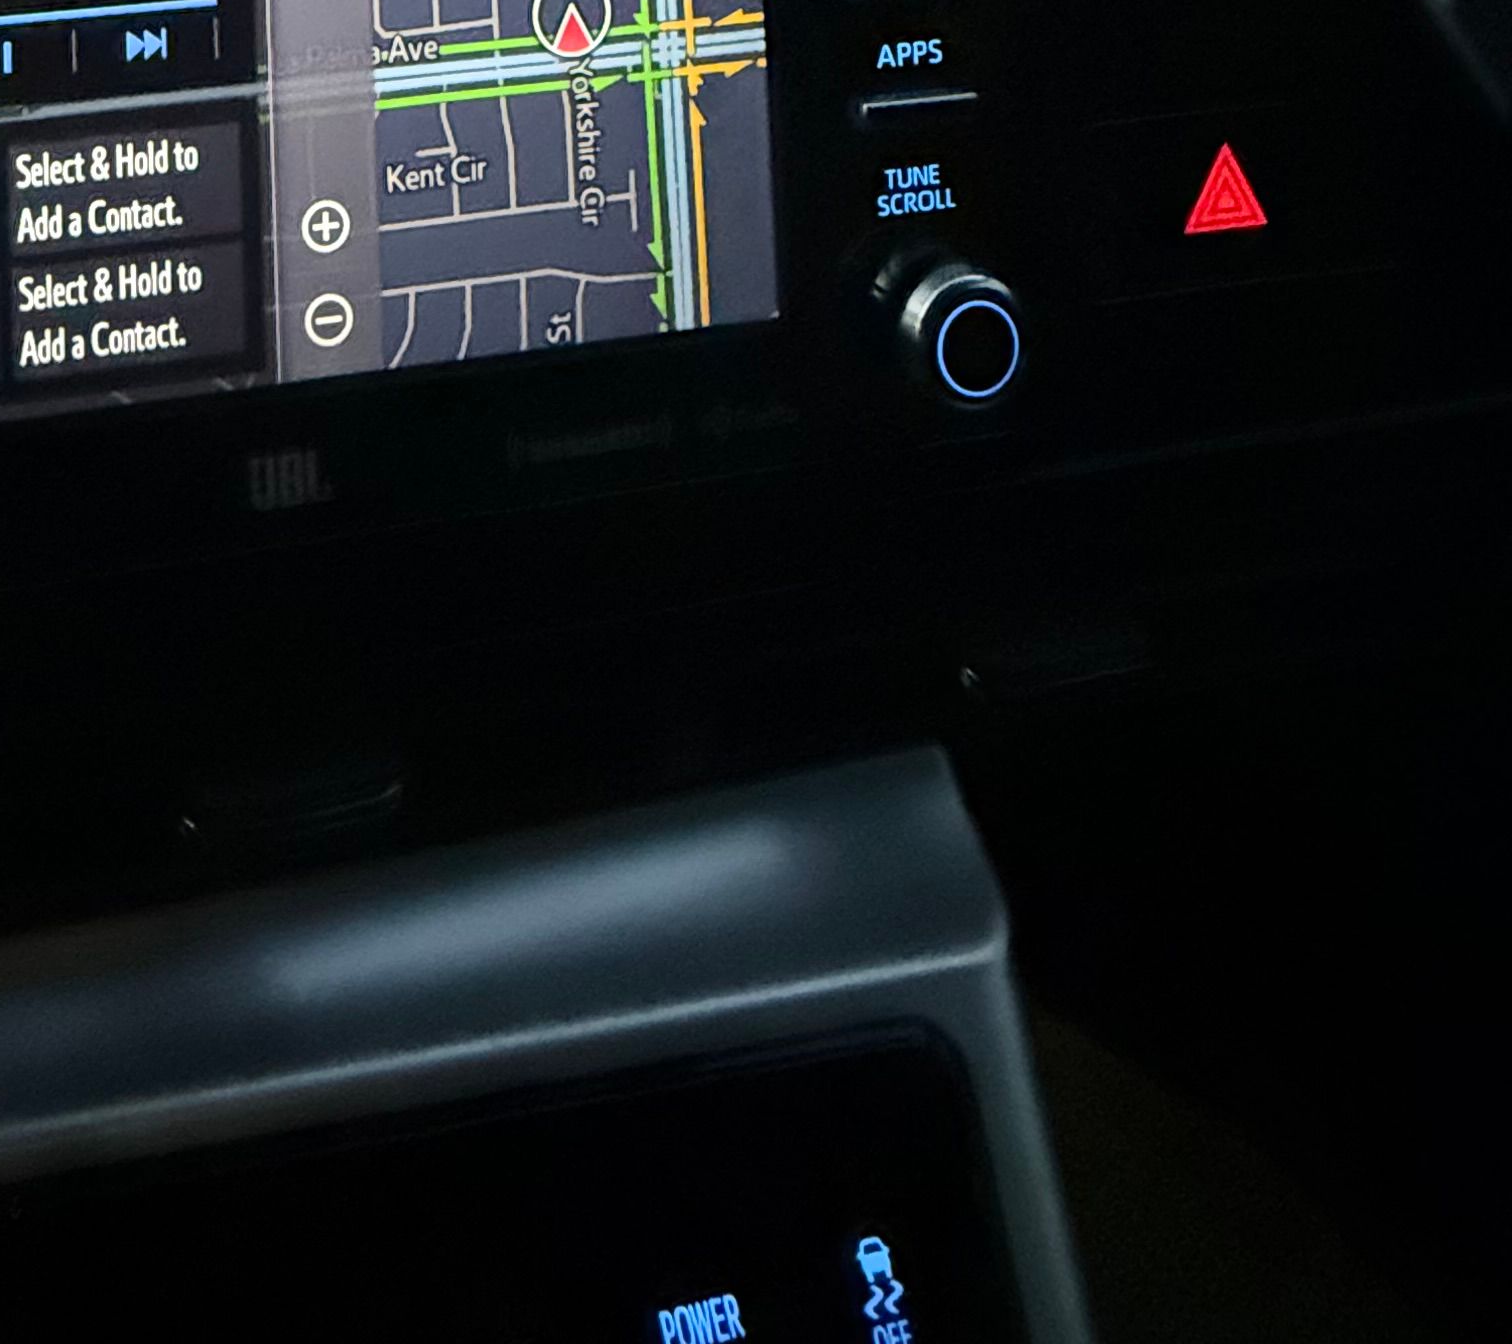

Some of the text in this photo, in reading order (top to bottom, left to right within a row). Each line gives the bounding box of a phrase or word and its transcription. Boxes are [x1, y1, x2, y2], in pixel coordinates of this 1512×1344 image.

[388, 33, 439, 63] Ave
[876, 39, 943, 69] APPS
[16, 138, 199, 189] Select & Hold to
[569, 57, 606, 227] Yorkshire Cir
[386, 154, 487, 194] Kent Cir
[884, 164, 941, 189] TUNE
[16, 195, 183, 243] Add a Contact.
[877, 188, 956, 217] SCROLL
[18, 259, 203, 312] Select & Hold to
[19, 316, 186, 368] Add a Contact.
[658, 1293, 746, 1344] POWER
[872, 1319, 912, 1344] OFF
